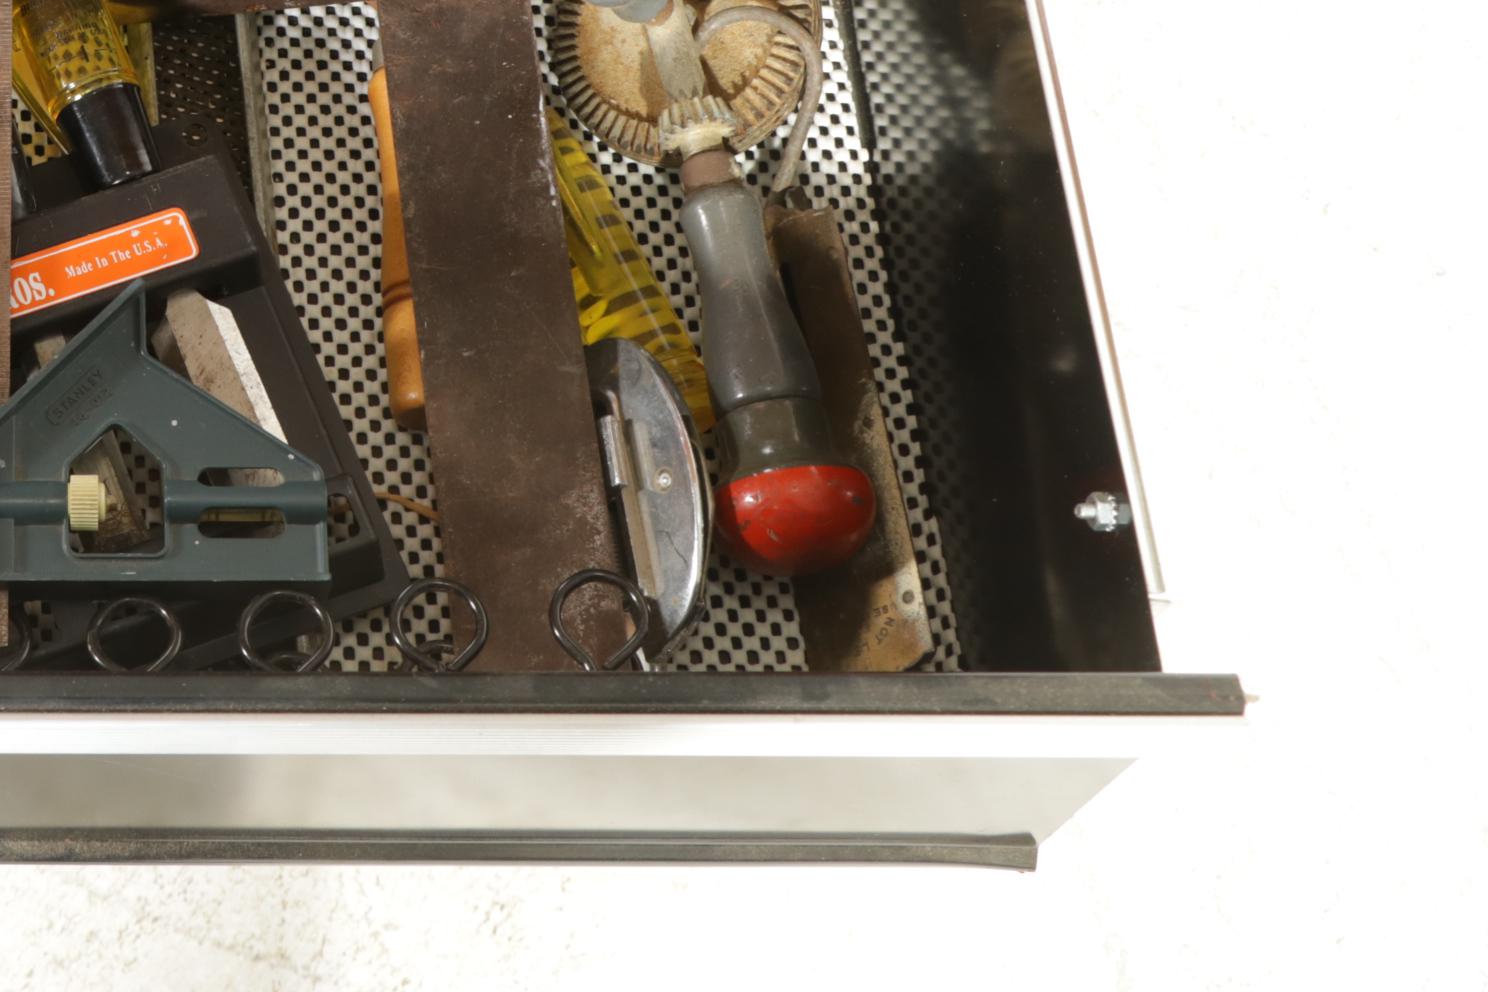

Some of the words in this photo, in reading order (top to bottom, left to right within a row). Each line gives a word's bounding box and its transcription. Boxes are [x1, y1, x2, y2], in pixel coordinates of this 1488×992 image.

[9, 272, 56, 309] OS.
[64, 260, 94, 279] Made
[96, 256, 109, 269] In
[110, 250, 132, 265] The
[132, 237, 168, 257] U.S.A.
[52, 367, 103, 418] STANLEY
